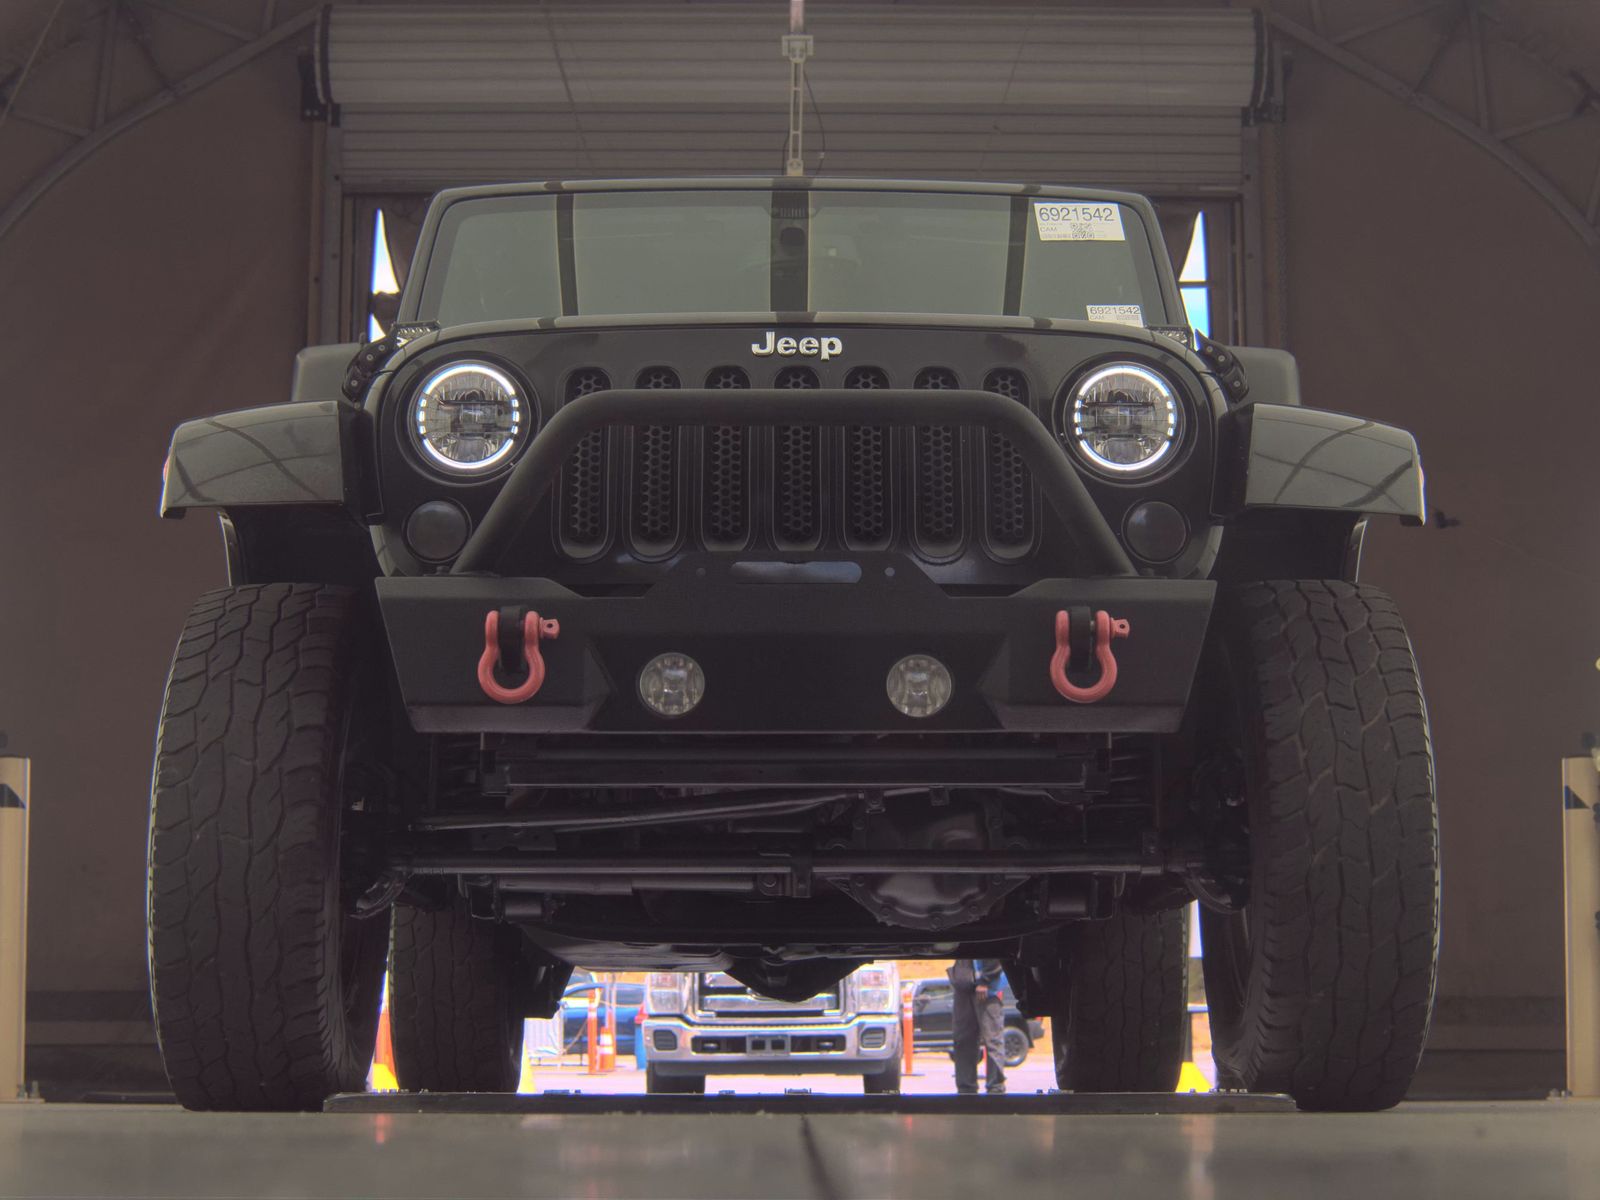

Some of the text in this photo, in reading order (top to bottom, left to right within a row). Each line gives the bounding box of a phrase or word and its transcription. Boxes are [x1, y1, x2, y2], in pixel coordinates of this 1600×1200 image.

[1039, 207, 1115, 221] 6921542
[1090, 306, 1141, 315] 6921542
[751, 331, 843, 360] Jeep
